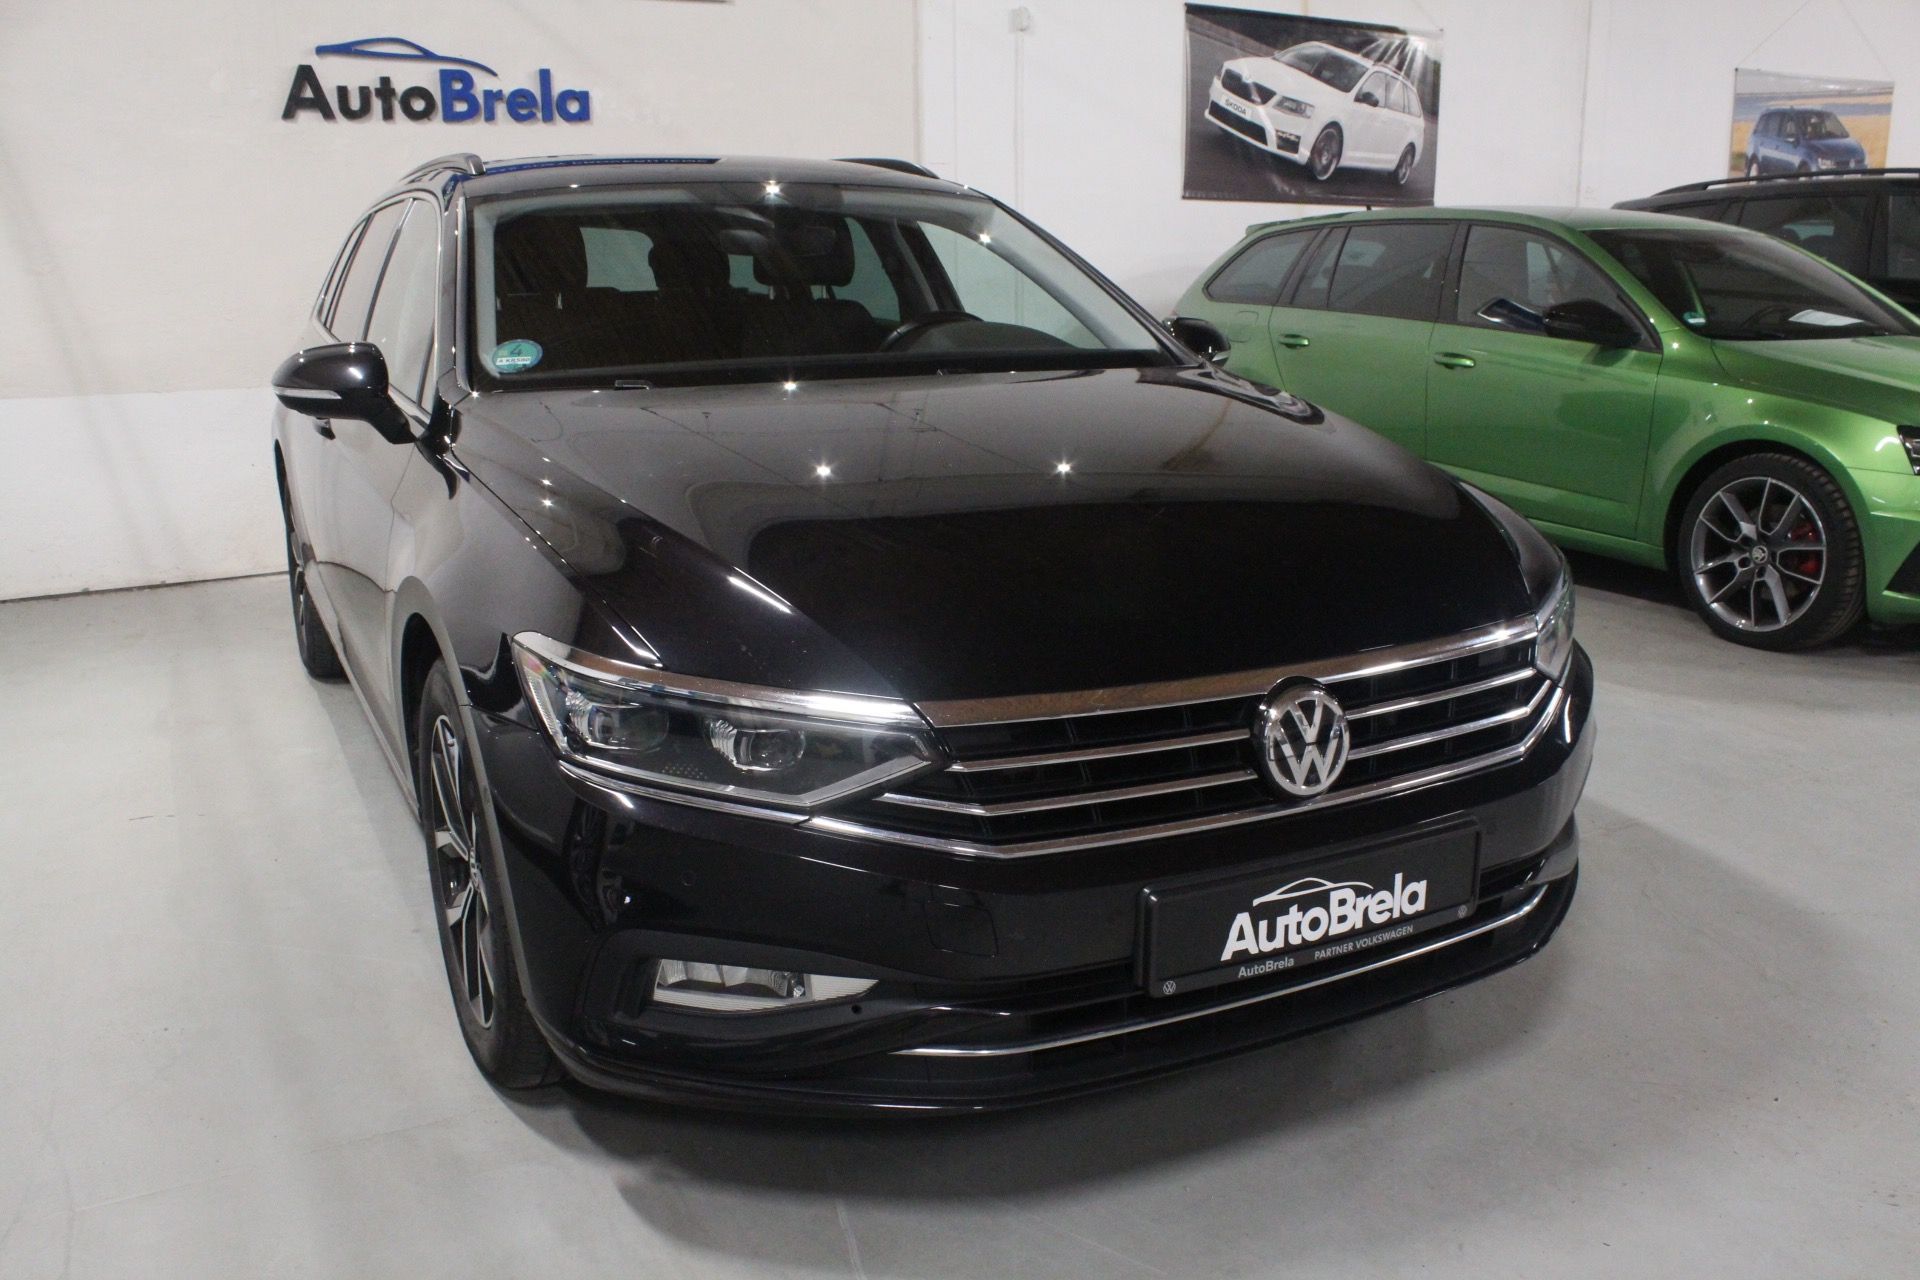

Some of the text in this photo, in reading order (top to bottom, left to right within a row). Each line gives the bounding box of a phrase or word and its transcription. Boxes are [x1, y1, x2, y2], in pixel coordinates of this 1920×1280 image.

[281, 64, 591, 123] AutoBrela
[1221, 872, 1427, 961] AutoBrela
[1314, 925, 1414, 960] PARTNER VOLKSWAGEN
[1238, 957, 1295, 979] AutoBrela
